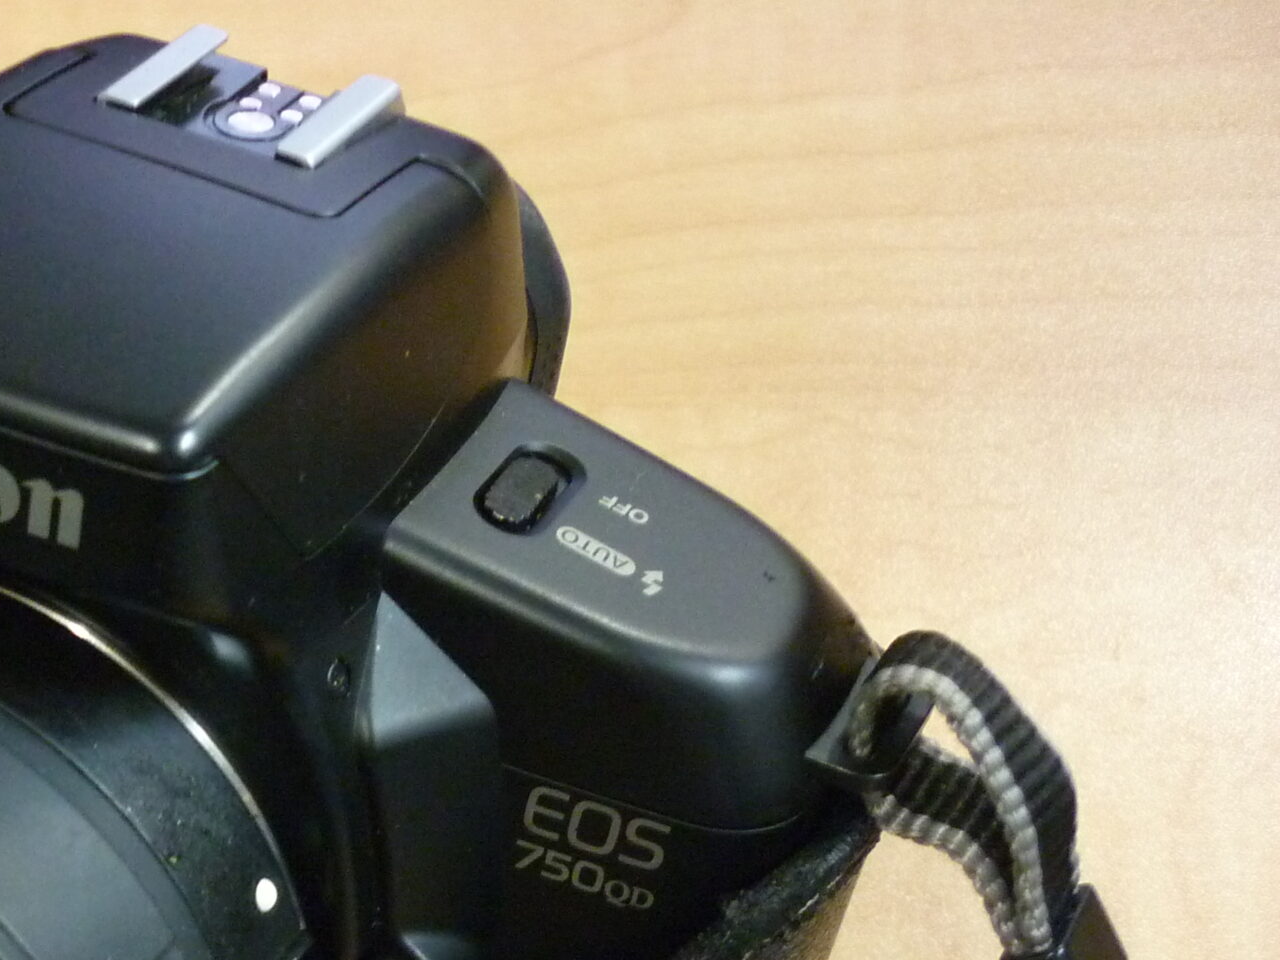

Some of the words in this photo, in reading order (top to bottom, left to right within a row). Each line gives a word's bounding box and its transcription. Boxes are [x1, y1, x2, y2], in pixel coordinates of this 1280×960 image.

[598, 495, 650, 525] OFF
[560, 528, 632, 571] AUTO
[522, 785, 672, 871] EOS
